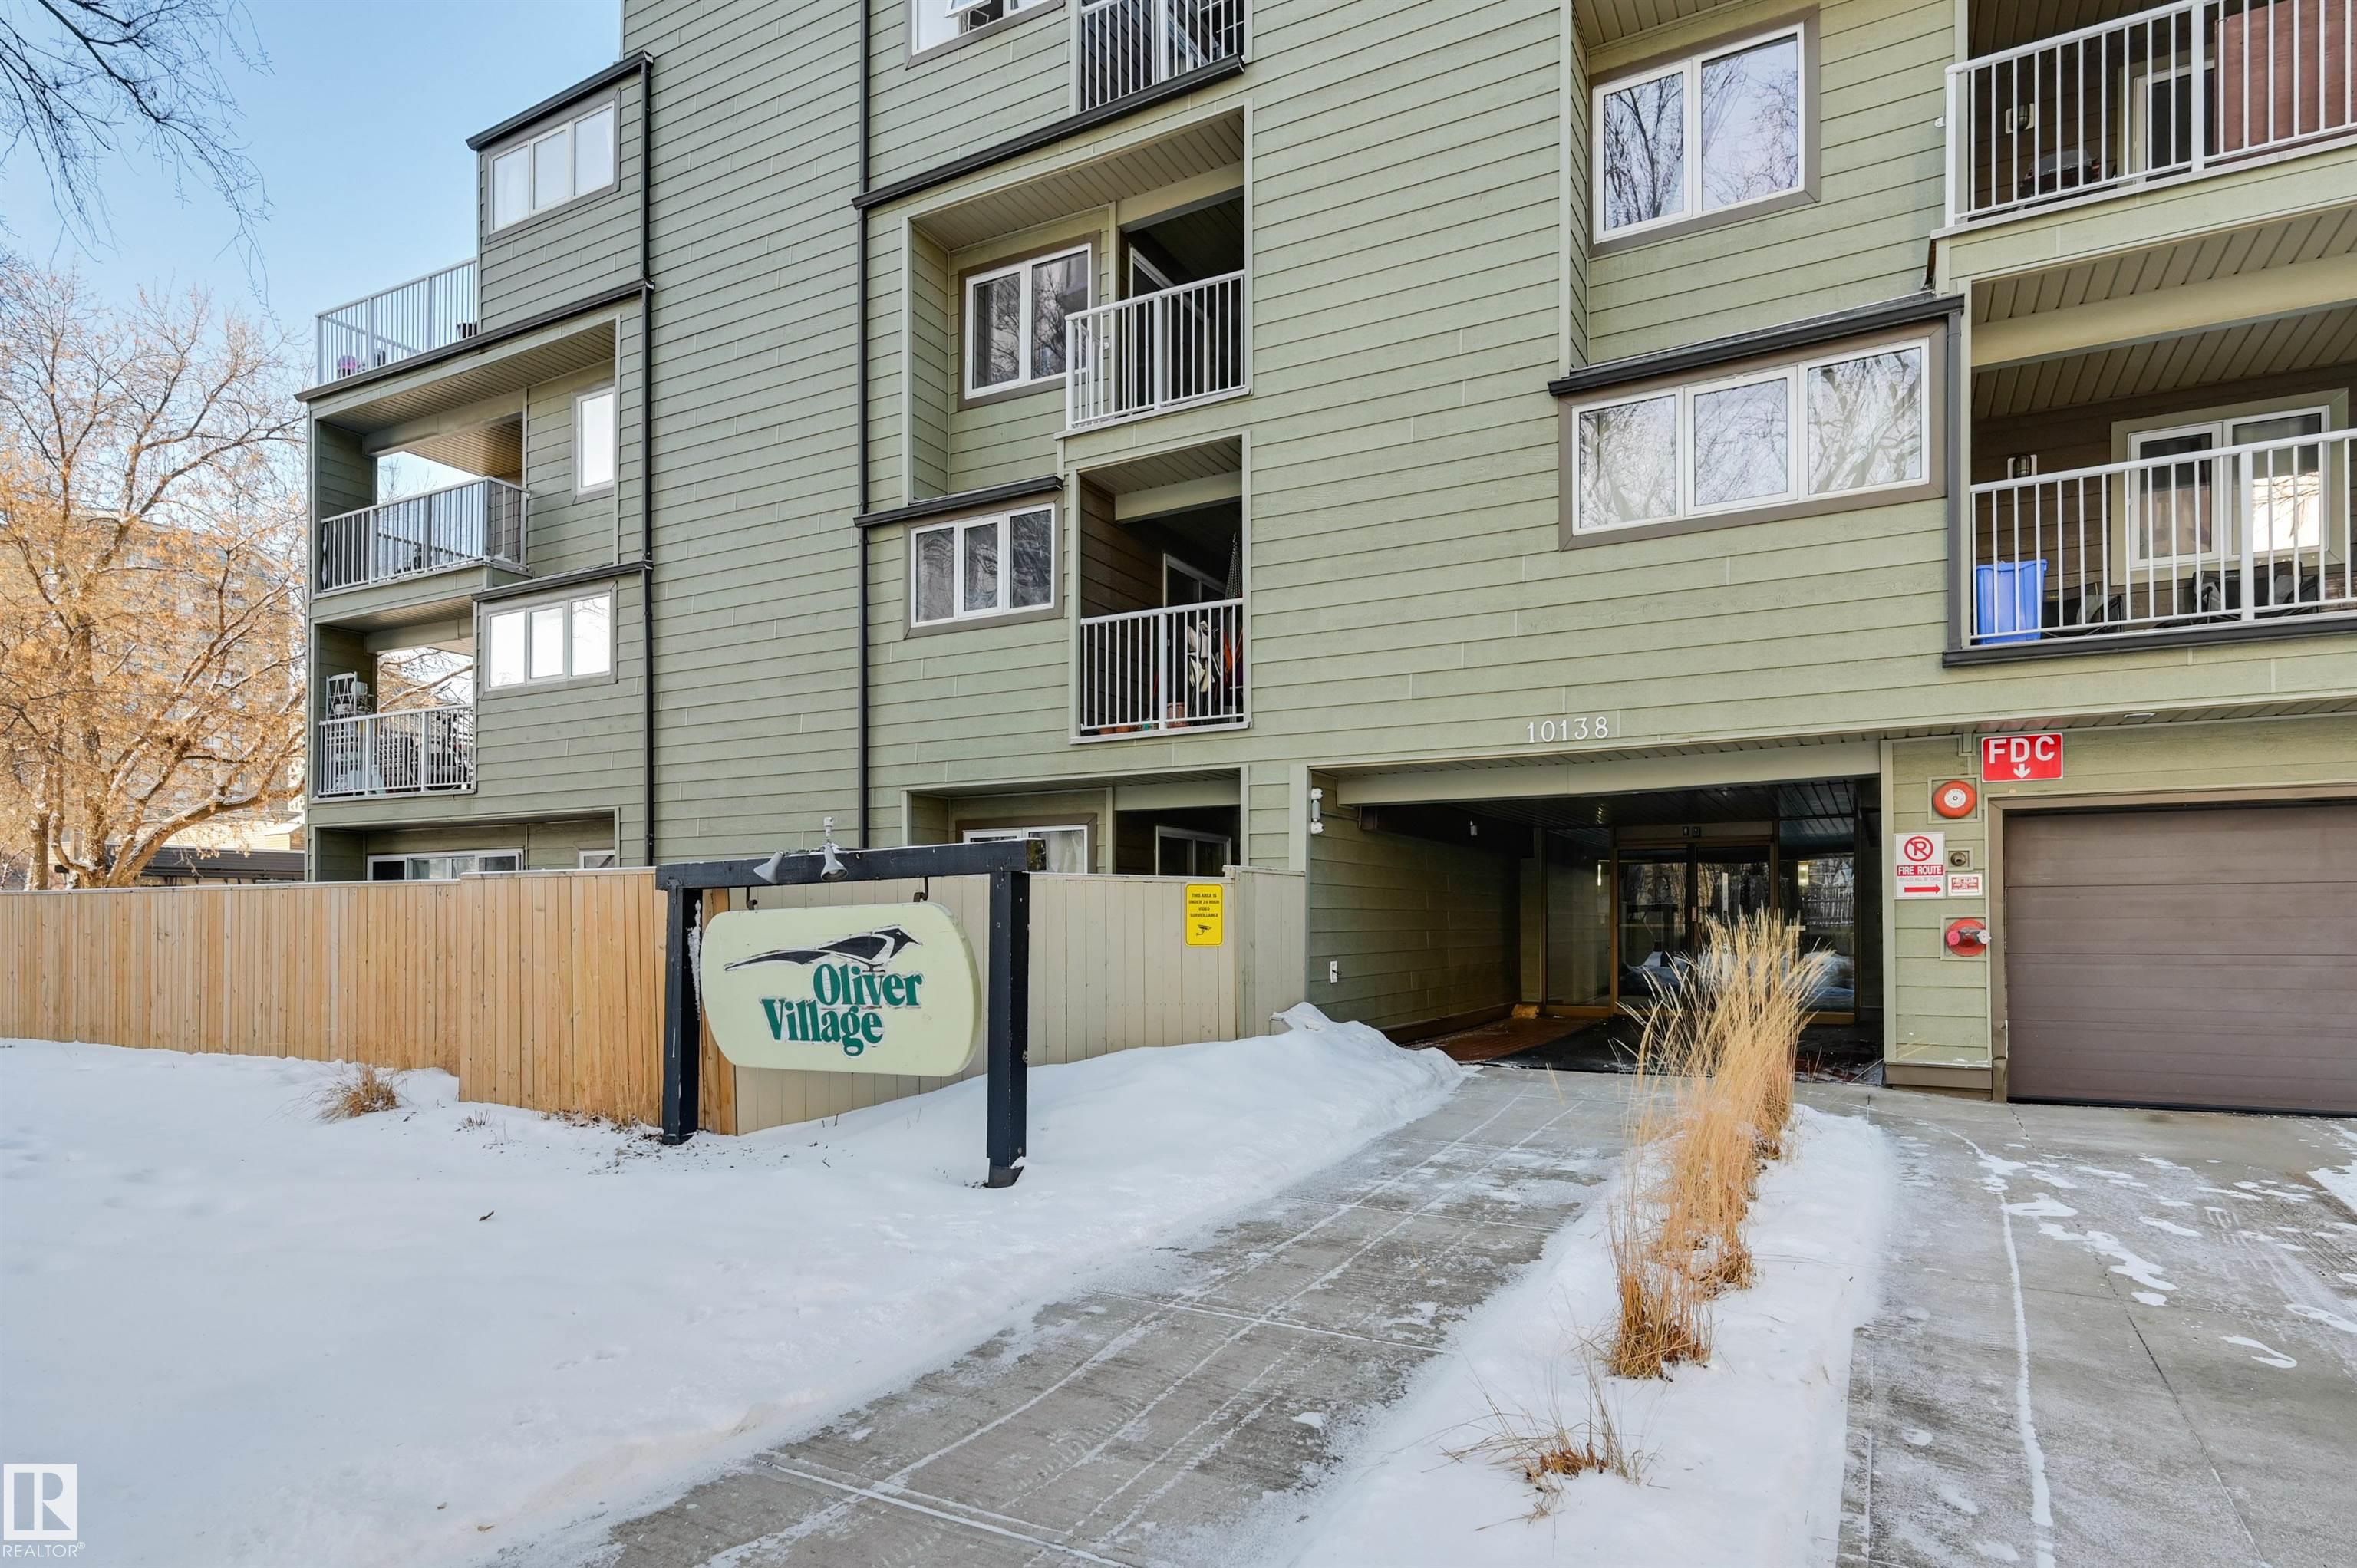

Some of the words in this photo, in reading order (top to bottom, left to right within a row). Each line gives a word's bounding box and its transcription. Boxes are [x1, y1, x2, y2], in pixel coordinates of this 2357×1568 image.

[1527, 716, 1608, 743] 10138
[1989, 736, 2055, 764] FDC
[1898, 866, 1914, 875] FIRE
[1917, 865, 1942, 875] ROUTE
[813, 963, 923, 1006] Oliver
[761, 999, 883, 1056] Village
